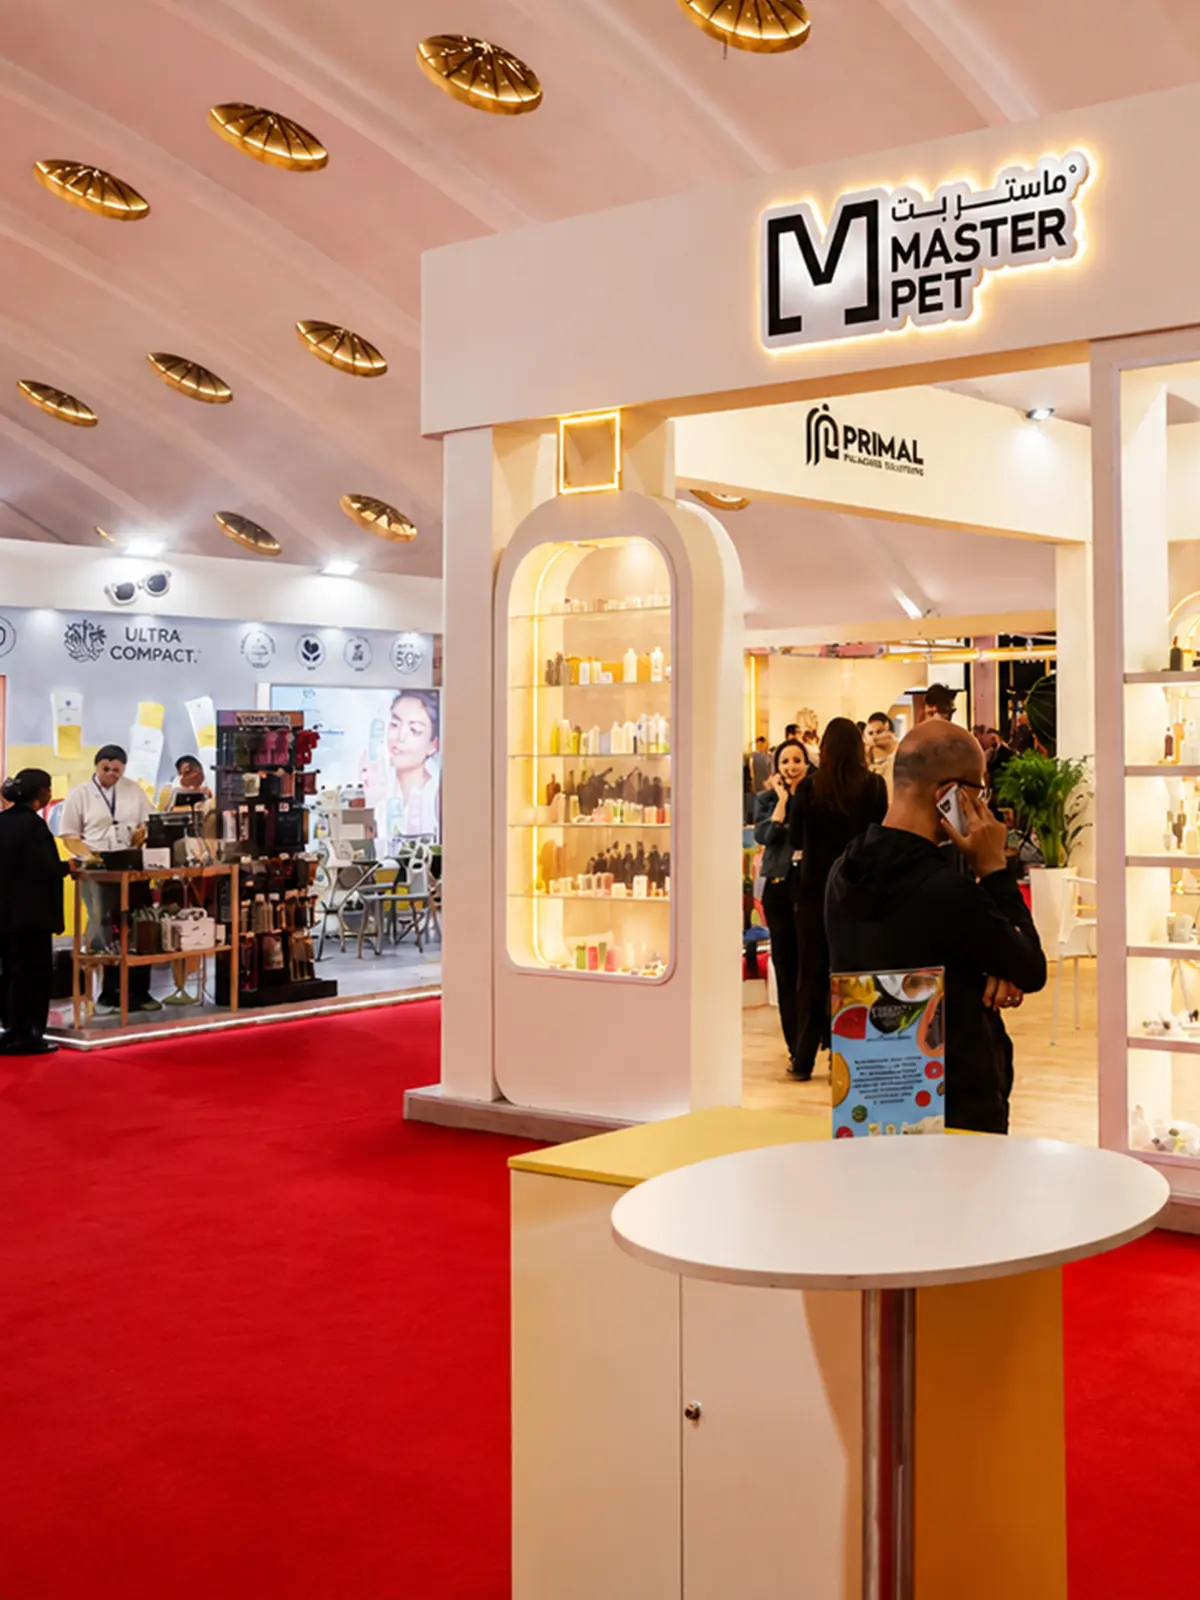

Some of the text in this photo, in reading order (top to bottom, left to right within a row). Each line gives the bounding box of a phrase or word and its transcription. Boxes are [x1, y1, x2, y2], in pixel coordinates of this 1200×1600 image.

[891, 207, 1067, 273] MASTER
[891, 268, 972, 319] PET
[843, 424, 924, 465] PRIMAL
[125, 626, 182, 644] ULTRA
